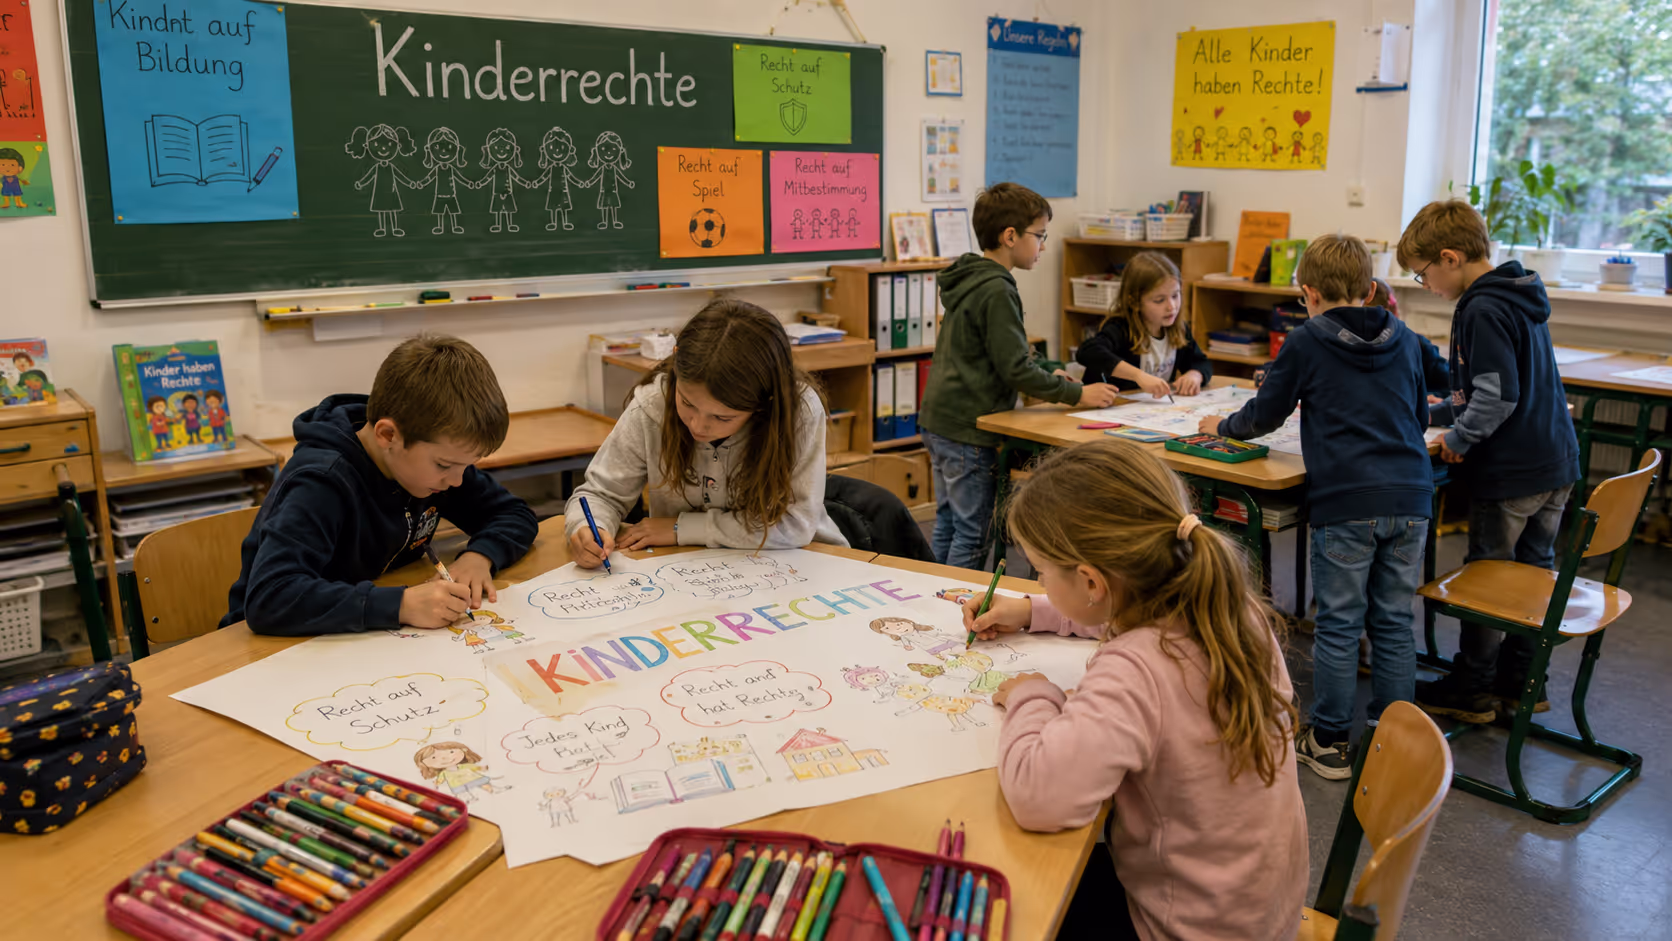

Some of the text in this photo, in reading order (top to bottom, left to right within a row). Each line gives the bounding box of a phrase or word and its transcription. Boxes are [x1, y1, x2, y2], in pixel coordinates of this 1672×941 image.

[208, 10, 257, 45] auf
[1003, 27, 1034, 45] Unsere
[1192, 35, 1314, 65] Alle Kinder
[136, 41, 244, 91] Bildung
[374, 22, 698, 108] Kinderrechte
[760, 53, 823, 79] Recht auf
[771, 77, 812, 95] Schutz
[1193, 67, 1323, 95] haben Rechte!
[678, 155, 742, 176] Recht auf
[795, 157, 852, 178] Recht auf
[692, 179, 725, 202] Spiel
[784, 180, 868, 202] Mitbestimmung
[143, 361, 215, 378] Kinder haben
[161, 375, 202, 389] Rechte
[542, 586, 601, 603] Recht
[681, 668, 777, 697] Recht and
[317, 682, 422, 721] Recht auf
[696, 699, 735, 716] hat
[349, 705, 440, 735] Schutz
[518, 731, 578, 749] Jedes
